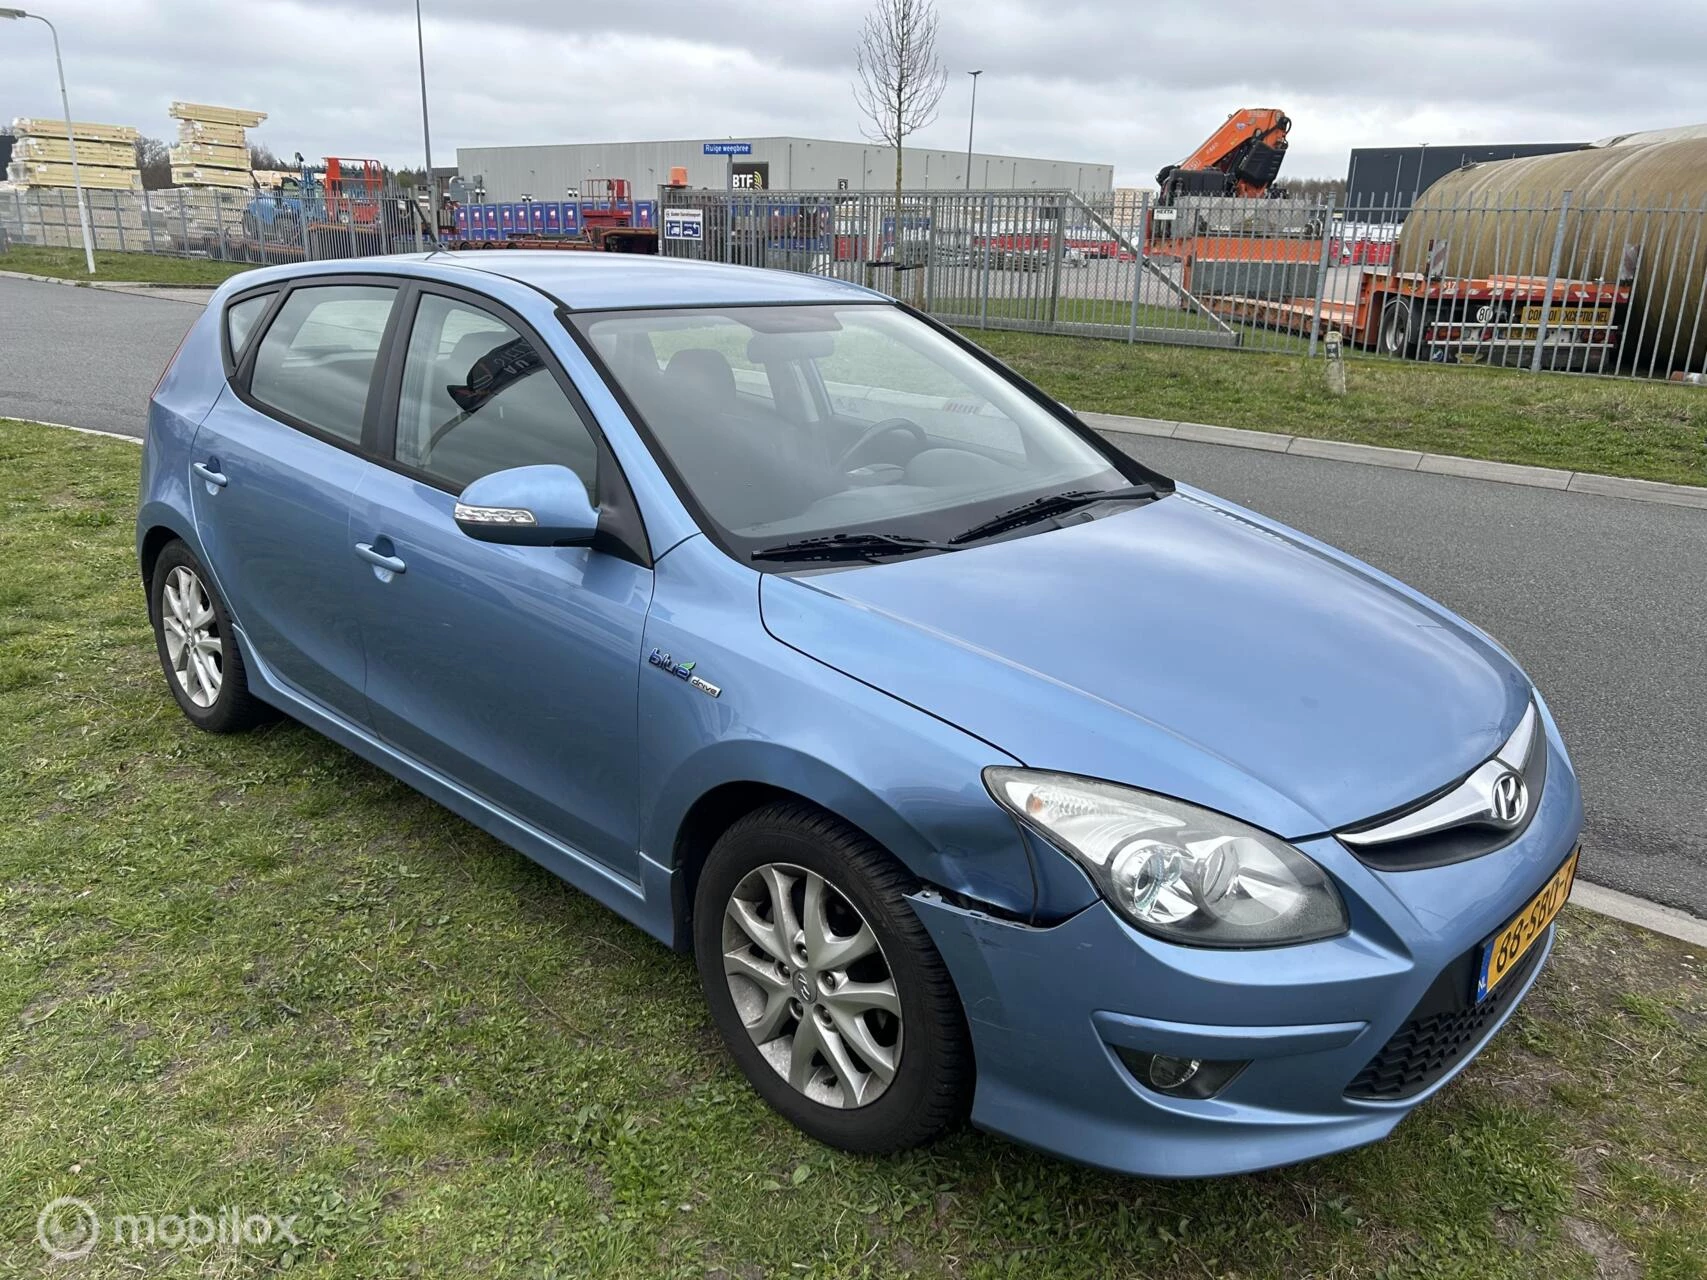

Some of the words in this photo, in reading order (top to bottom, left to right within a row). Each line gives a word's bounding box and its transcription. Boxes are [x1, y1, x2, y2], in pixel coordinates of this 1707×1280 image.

[705, 144, 721, 153] Ruige
[722, 144, 749, 154] weegbree
[733, 174, 753, 188] BTF
[648, 647, 692, 682] blue
[691, 678, 718, 697] drive
